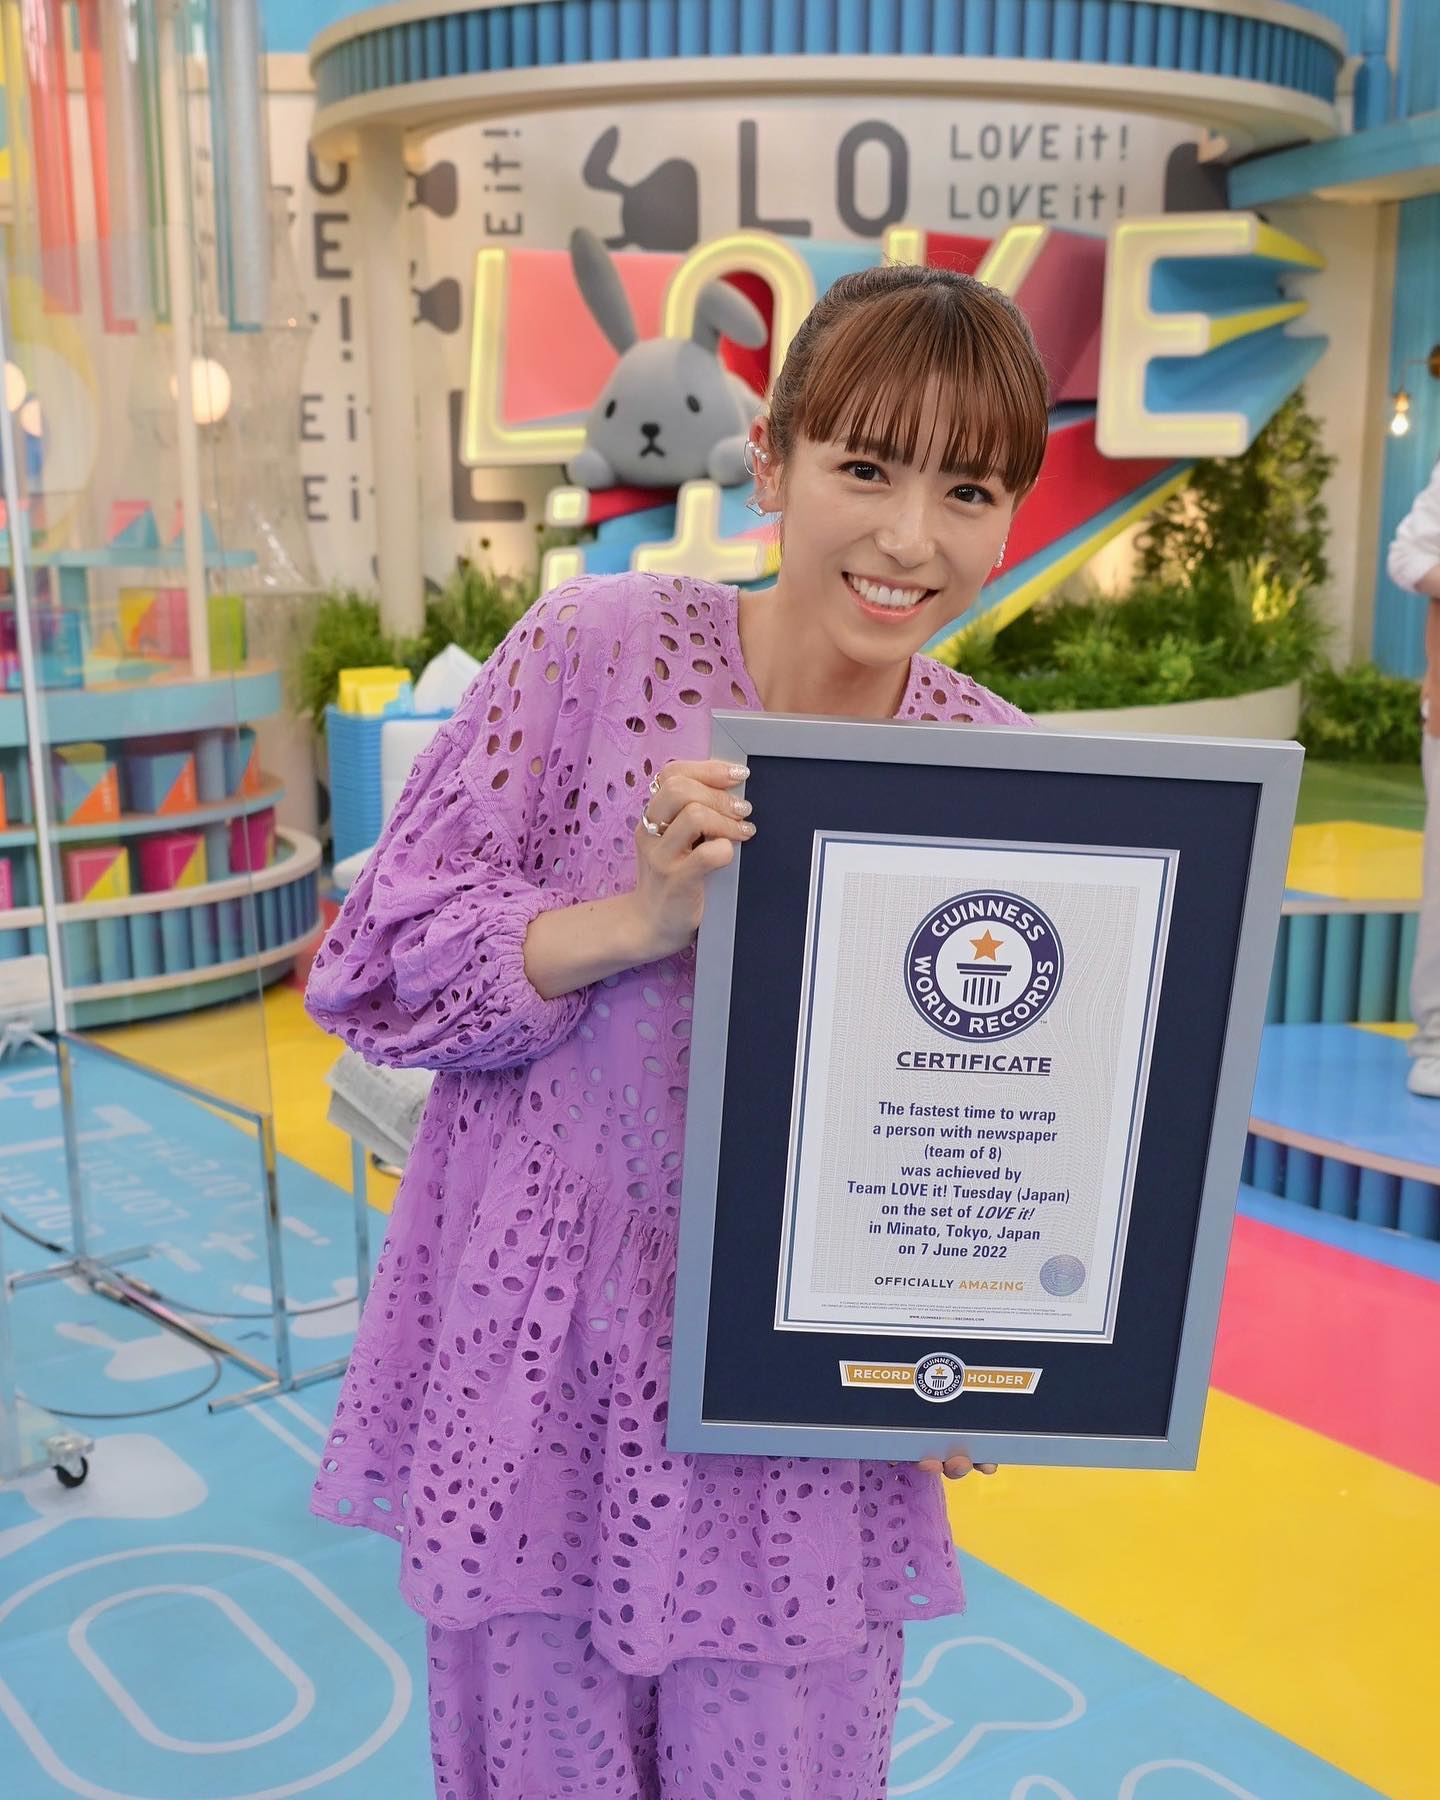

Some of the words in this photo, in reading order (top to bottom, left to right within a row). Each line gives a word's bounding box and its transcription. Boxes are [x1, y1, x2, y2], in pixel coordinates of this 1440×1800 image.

[951, 124, 1060, 160] LOVE
[1075, 124, 1127, 160] it!
[949, 184, 1058, 220] LOVE
[1073, 184, 1125, 219] it!
[931, 900, 1045, 941] GUINNESS
[914, 955, 961, 1026] WORLD
[969, 960, 1054, 1034] RECORDS
[896, 1051, 1053, 1074] CERTIFICATE
[879, 1101, 904, 1115] The
[910, 1103, 959, 1117] fastest
[964, 1105, 995, 1119] time
[1001, 1108, 1014, 1120] to
[1020, 1110, 1056, 1124] wrap
[873, 1125, 880, 1134] a
[886, 1125, 935, 1138] person
[941, 1125, 972, 1138] with
[977, 1128, 1057, 1143] newspaper
[925, 1144, 964, 1159] (team
[970, 1146, 983, 1159] of
[989, 1147, 1002, 1162] 8)
[901, 1166, 931, 1177] was
[936, 1166, 999, 1180] achieved
[1005, 1168, 1021, 1183] by
[848, 1181, 886, 1195] Team
[892, 1183, 928, 1197] LOVE
[933, 1185, 947, 1198] it!
[953, 1186, 1012, 1202] Tuesday
[1018, 1188, 1070, 1204] (Japan)
[882, 1205, 898, 1215] on
[904, 1204, 925, 1216] the
[931, 1206, 952, 1217] set
[957, 1206, 972, 1218] of
[976, 1206, 1015, 1219] LOVE
[1018, 1208, 1035, 1220] it!
[870, 1222, 881, 1234] in
[887, 1222, 940, 1237] Minato,
[947, 1225, 992, 1240] Tokyo,
[997, 1227, 1040, 1242] Japan
[899, 1244, 915, 1255] on
[922, 1243, 928, 1255] 7
[933, 1244, 968, 1257] June
[973, 1246, 1007, 1258] 2022
[874, 1276, 954, 1288] OFFICIALLY
[958, 1280, 1024, 1291] AMAZING
[923, 1357, 958, 1369] GUINNESS
[854, 1368, 910, 1380] RECORD
[968, 1373, 1024, 1384] HOLDER
[917, 1373, 932, 1395] WORLD
[934, 1375, 960, 1396] RECORDS
